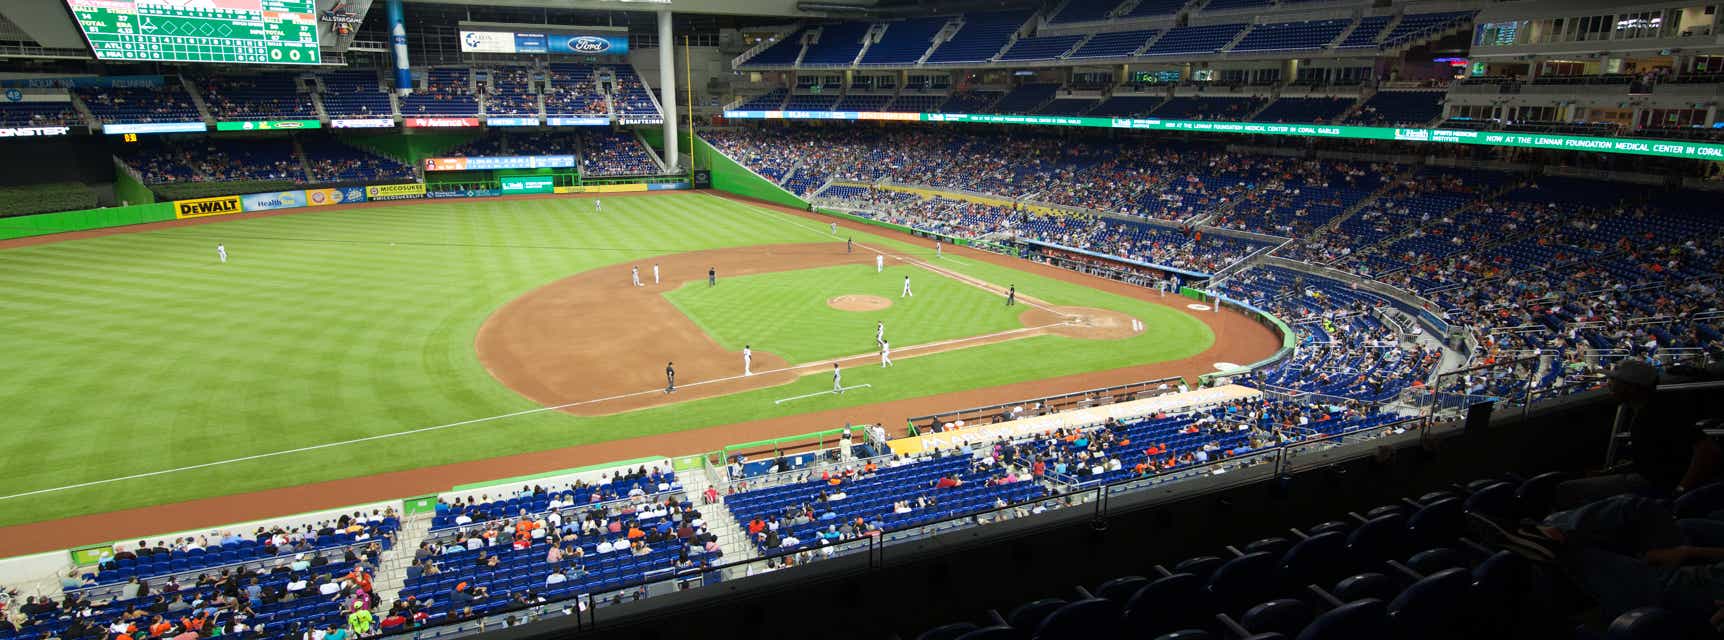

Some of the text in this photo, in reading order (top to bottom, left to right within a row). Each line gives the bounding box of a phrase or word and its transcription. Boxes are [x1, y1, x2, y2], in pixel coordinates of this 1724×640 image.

[576, 38, 602, 51] Ford
[271, 49, 315, 62] 0 0 1
[1535, 138, 1563, 146] LENNAR
[1566, 140, 1612, 148] FOUNDATION
[1615, 142, 1650, 151] MEDICAL
[1653, 144, 1684, 153] CENTER
[1697, 147, 1724, 157] CORAL
[380, 184, 423, 192] MICCOSUKEE
